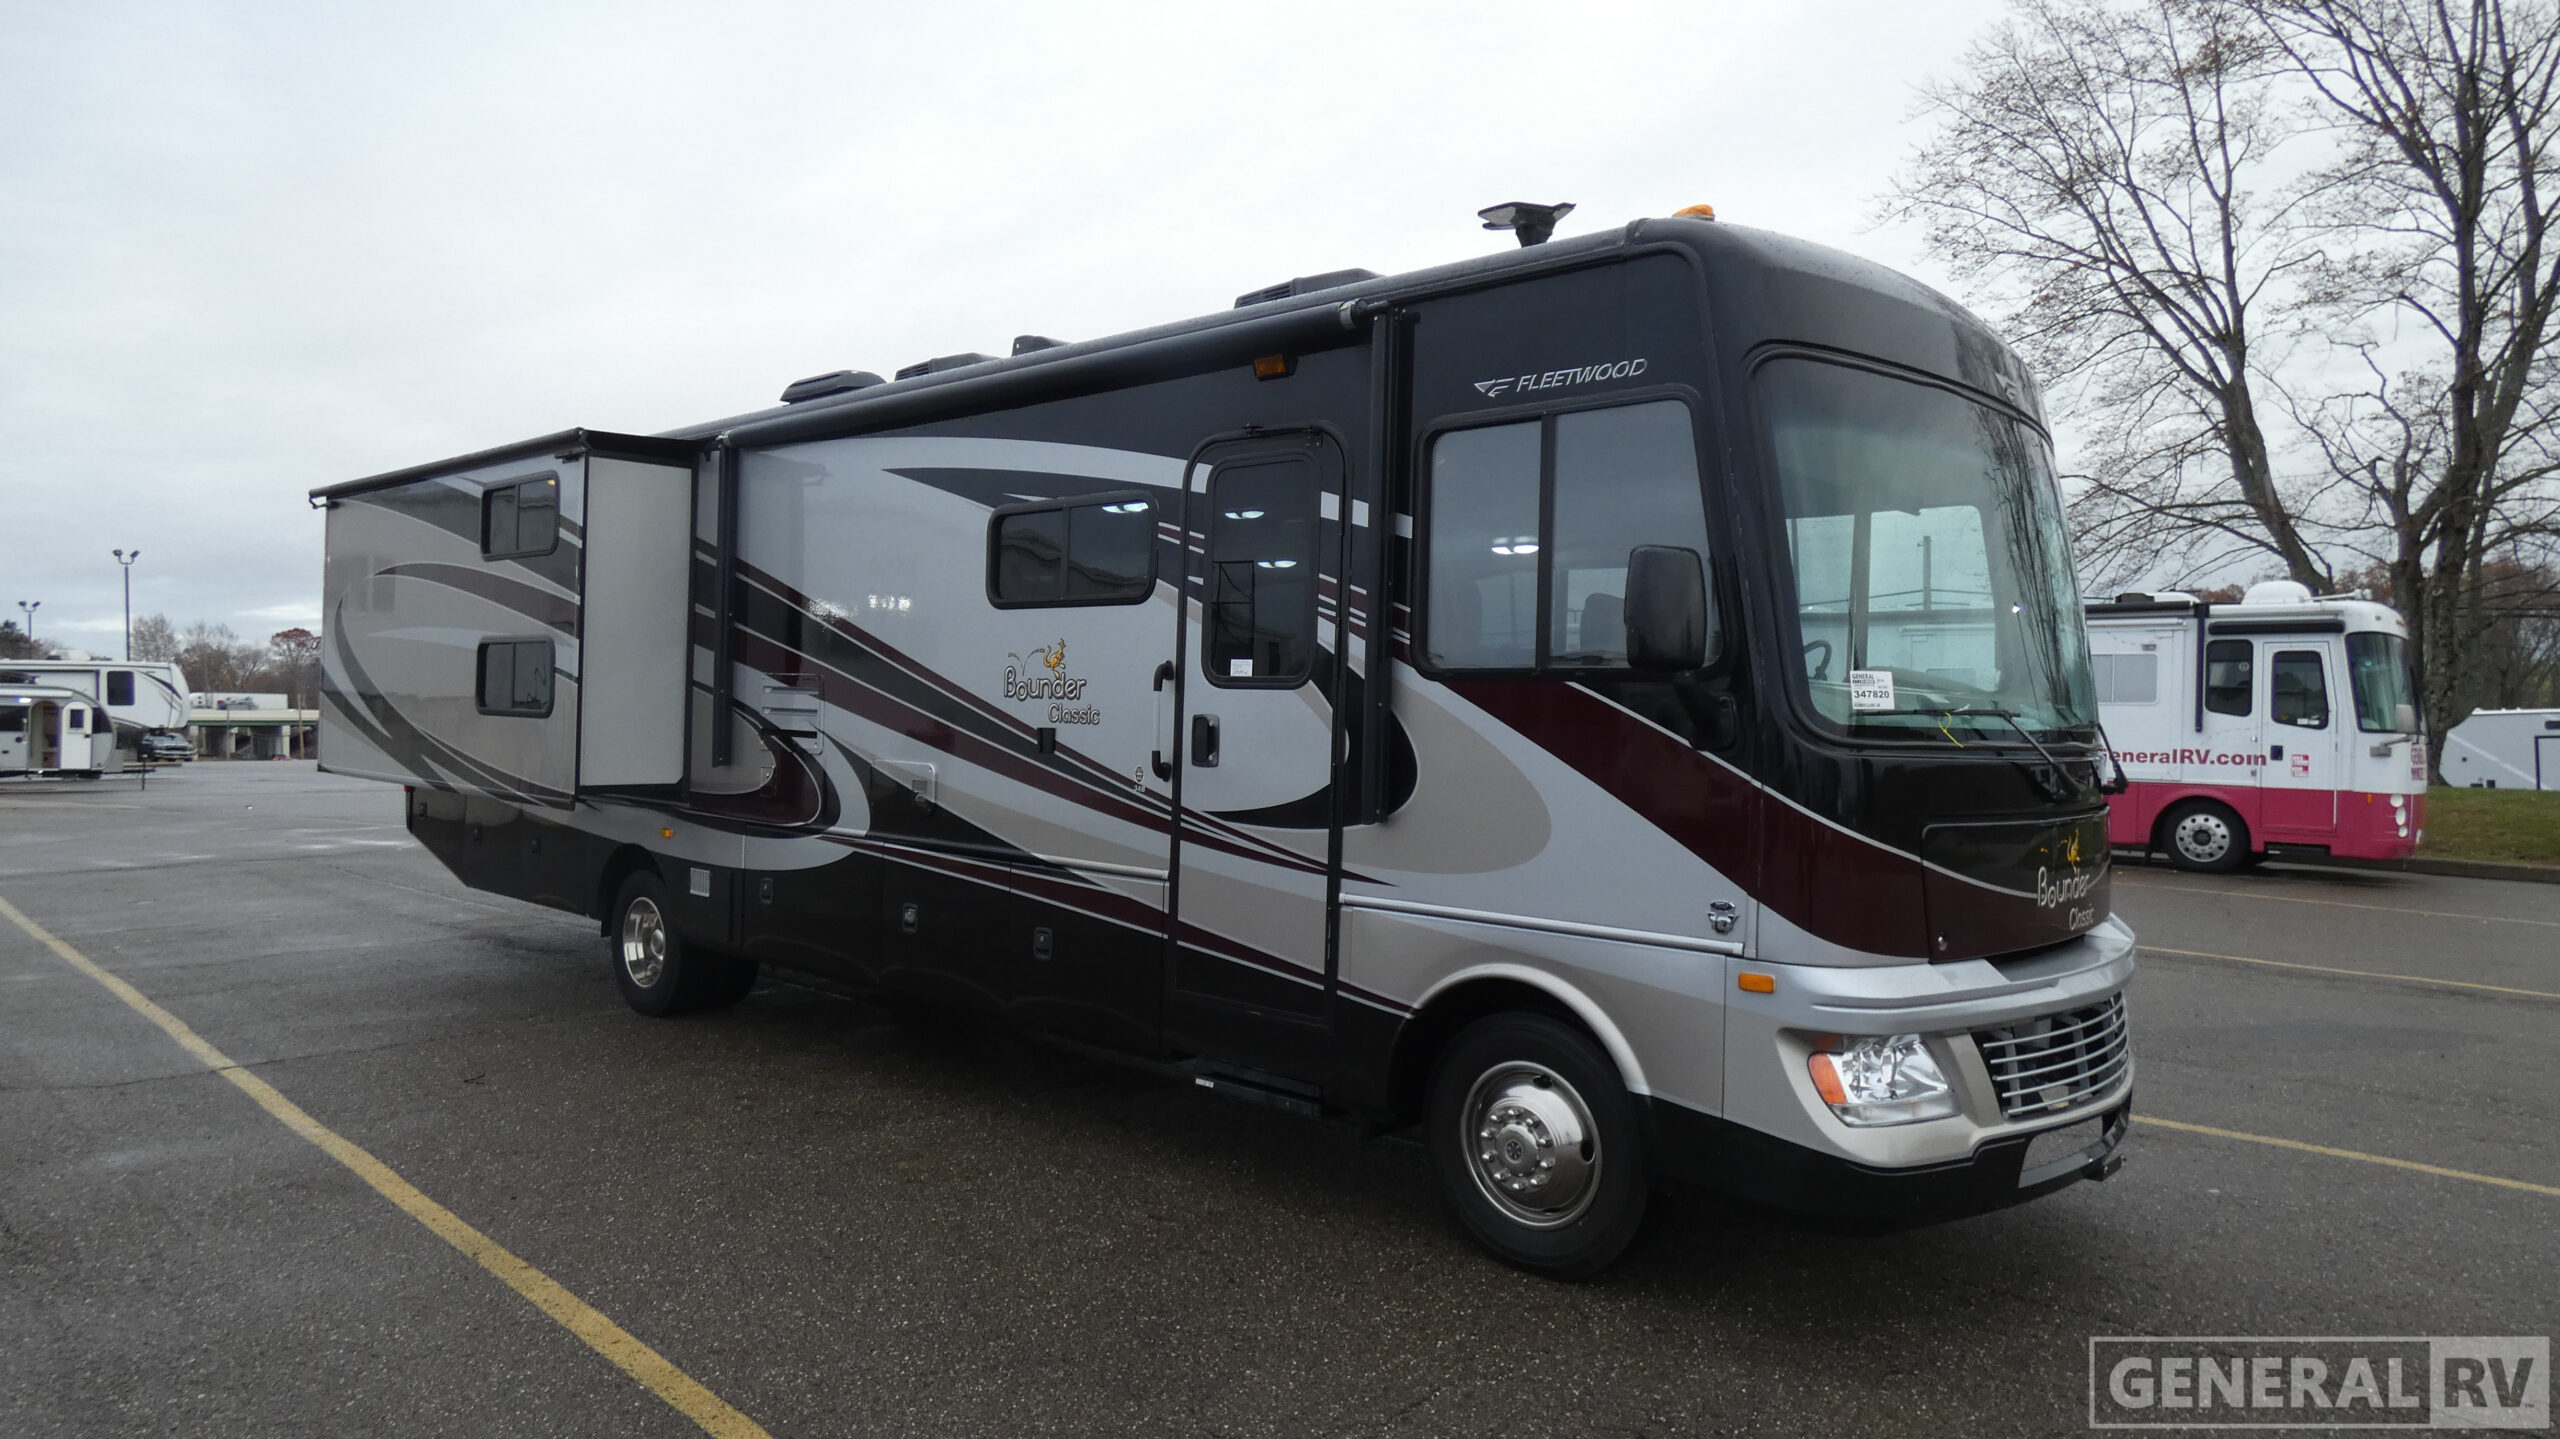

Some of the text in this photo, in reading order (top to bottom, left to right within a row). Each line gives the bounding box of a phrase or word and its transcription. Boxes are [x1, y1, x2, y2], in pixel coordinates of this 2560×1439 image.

[1516, 358, 1648, 392] FLEETWOOD
[1003, 665, 1087, 701] Bounder
[1854, 690, 1890, 699] 347820
[1048, 702, 1100, 725] Classic
[2037, 866, 2090, 909] Bounder
